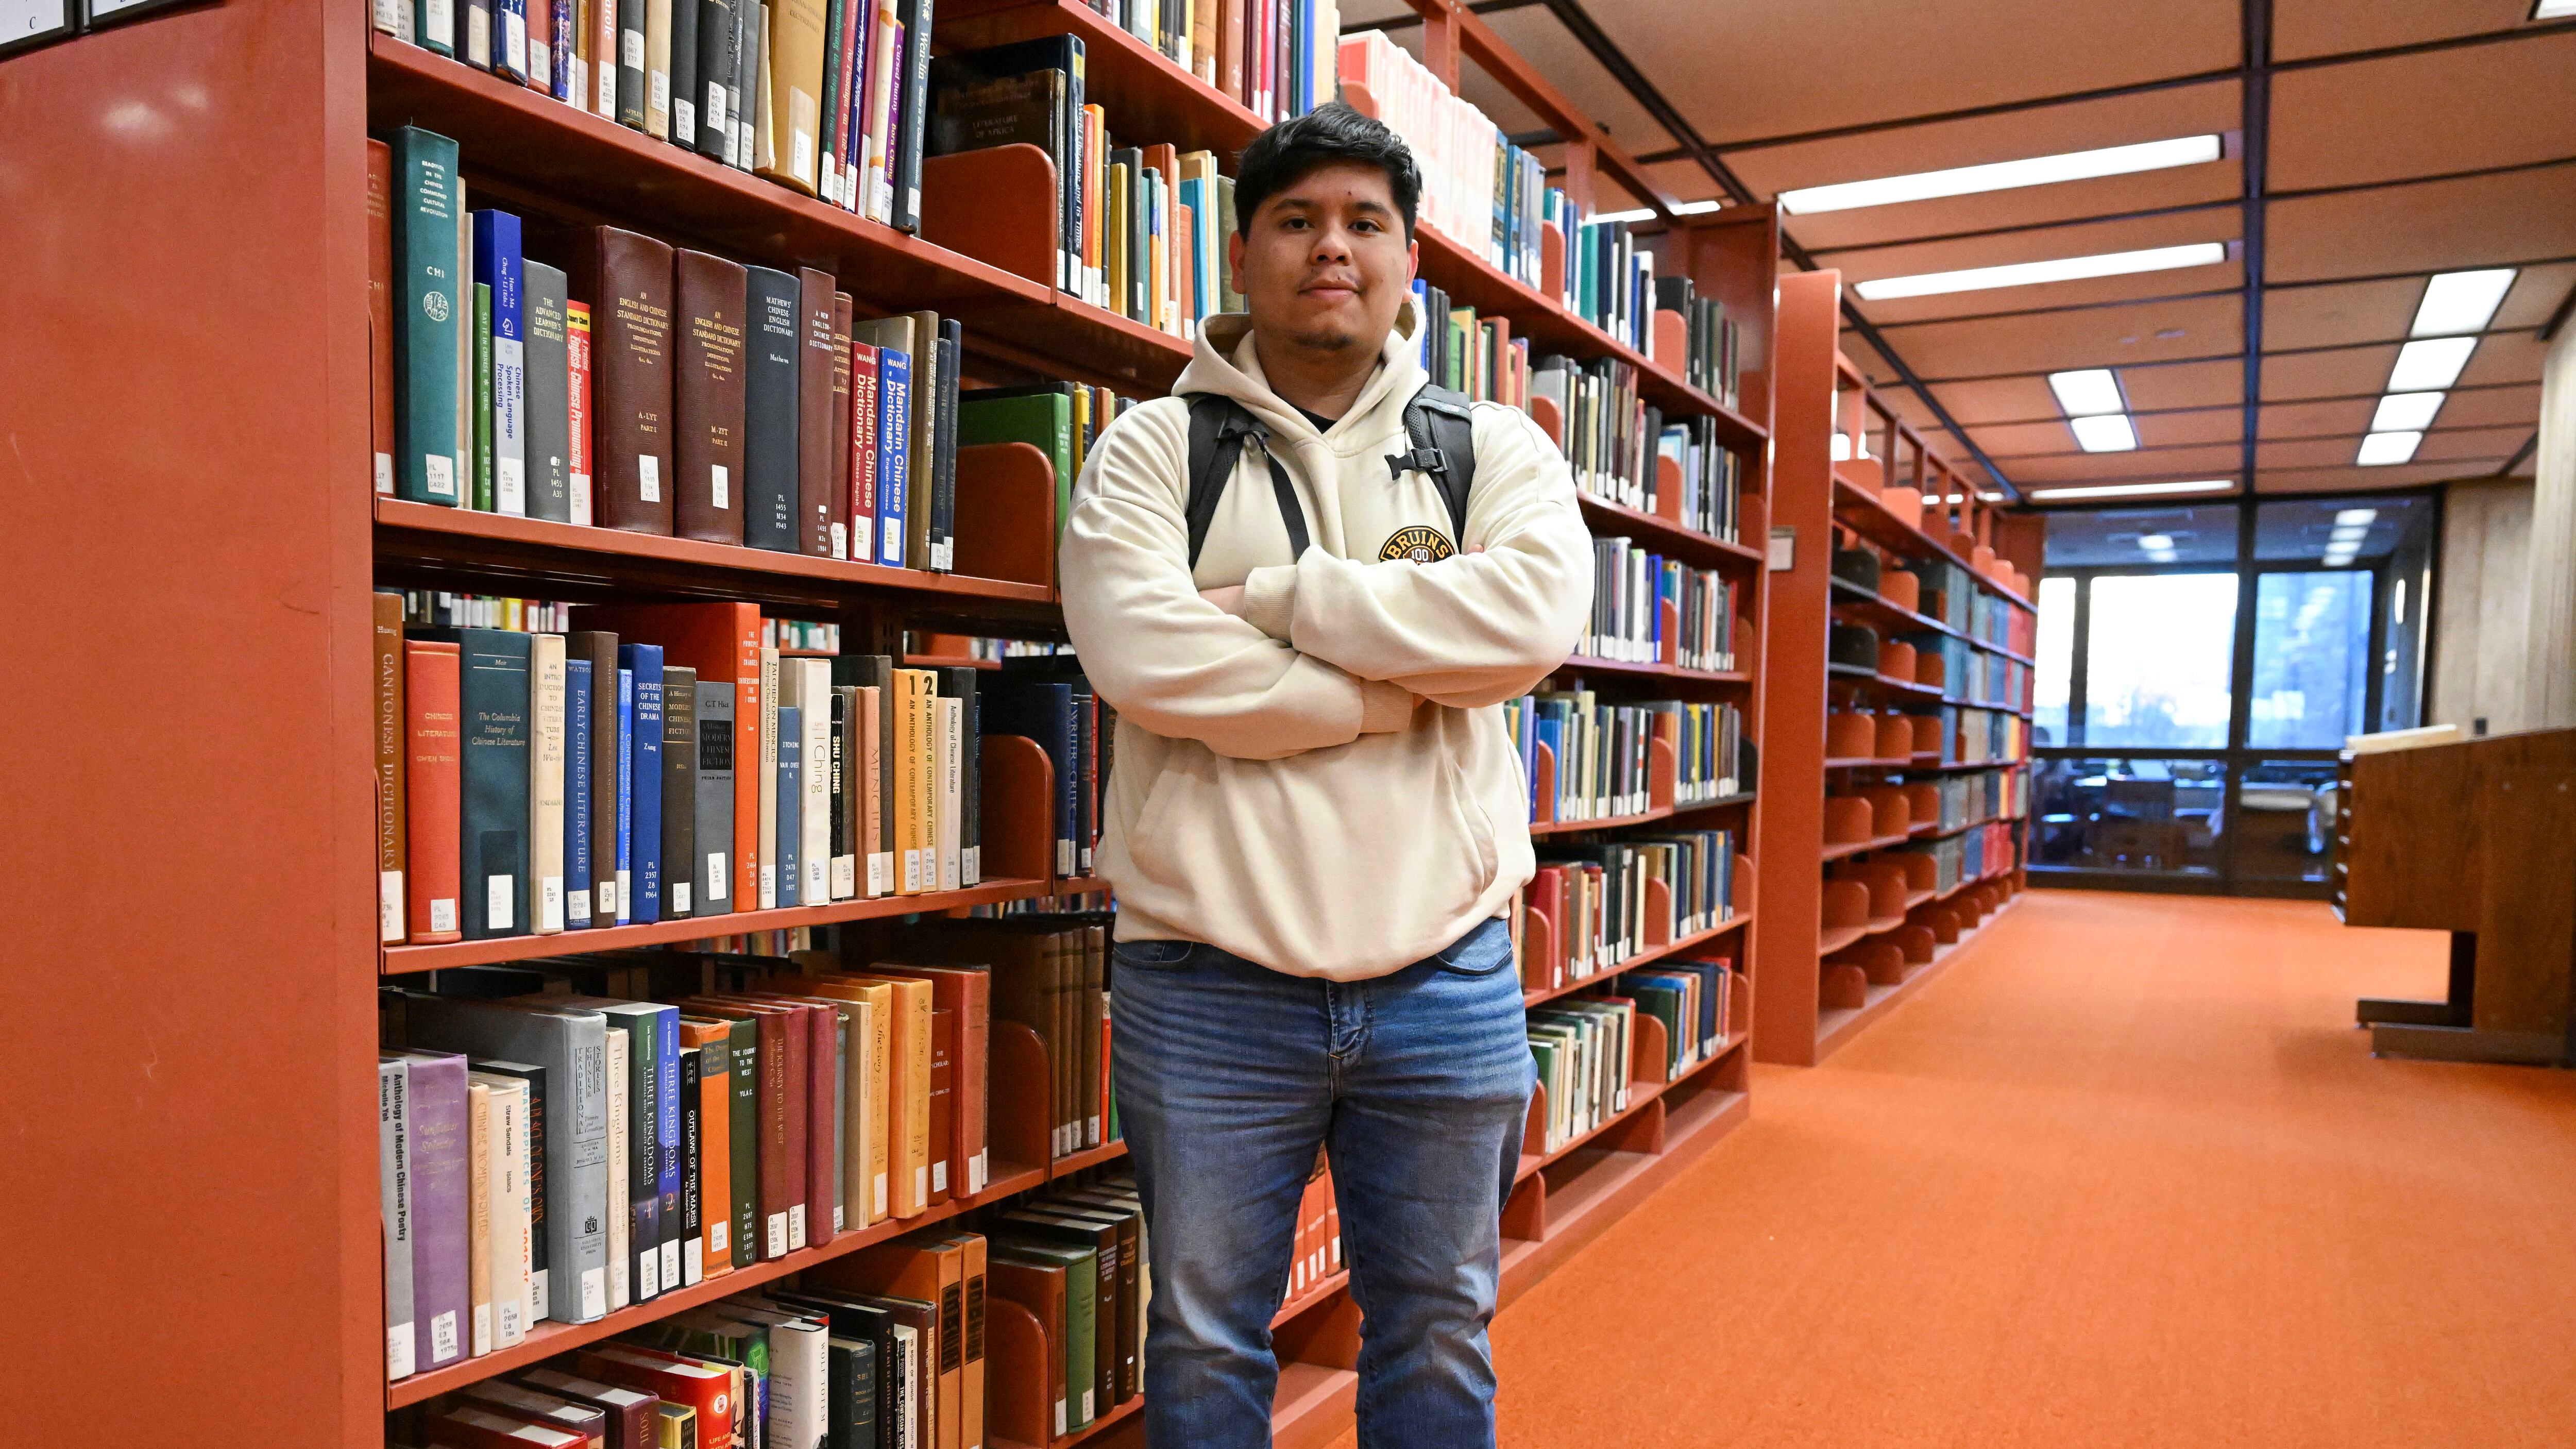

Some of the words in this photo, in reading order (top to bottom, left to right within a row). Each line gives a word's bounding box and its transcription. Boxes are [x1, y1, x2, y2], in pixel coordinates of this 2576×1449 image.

[29, 16, 36, 29] C
[894, 44, 902, 80] Cursed
[918, 32, 928, 80] Wen-lin
[891, 82, 901, 114] Bunny
[887, 149, 895, 180] Chung
[543, 297, 553, 308] THE
[619, 298, 639, 309] ENGLISH
[639, 302, 649, 312] AND
[649, 306, 667, 318] CHINESE
[766, 296, 792, 309] MATHEWS'
[535, 307, 562, 321] ADVANCED
[714, 311, 721, 319] AN
[767, 306, 790, 318] CHINESE-
[820, 311, 829, 320] NEW
[535, 317, 562, 331] LEARNER'S
[617, 310, 642, 323] STANDARD
[643, 316, 669, 330] DICTIONARY
[694, 317, 713, 329] ENGLISH
[714, 322, 722, 331] AND
[722, 325, 740, 336] CHINESE
[769, 316, 790, 326] ENGLISH
[534, 327, 564, 342] DICTIONARY
[692, 328, 717, 341] STANDARD
[717, 335, 741, 348] DICTIONARY
[764, 324, 793, 338] DICTIONARY
[814, 330, 831, 341] CHINESE
[809, 339, 833, 352] DICTIONARY
[856, 352, 876, 365] WANG
[887, 358, 907, 370] WANG
[569, 334, 583, 408] English-Chinese
[855, 373, 867, 449] Dictionary
[866, 376, 876, 445] Mandarin
[885, 378, 896, 454] Dictionary
[894, 382, 906, 450] Mandarin
[569, 408, 582, 468] Pronouncing
[865, 450, 875, 508] Chinese
[893, 454, 904, 513] Chinese
[552, 490, 563, 498] A35
[778, 494, 785, 502] PL
[775, 503, 787, 512] 1455
[776, 521, 787, 530] 1943
[817, 525, 827, 533] 1455
[817, 545, 827, 553] 1984
[1387, 531, 1449, 559] BRUINS
[1412, 548, 1429, 562] 100
[638, 682, 661, 691] SECRETS
[910, 675, 915, 695] 1
[924, 676, 933, 695] 2
[383, 653, 394, 754] CANTONESE
[650, 693, 659, 701] THE
[926, 699, 932, 709] AN
[578, 690, 586, 730] EARLY
[638, 702, 660, 711] CHINESE
[771, 705, 777, 718] ON
[909, 699, 916, 710] AN
[479, 713, 490, 721] The
[492, 713, 521, 722] Columbia
[640, 712, 659, 720] DRAMA
[485, 725, 506, 735] History
[508, 725, 515, 734] of
[472, 737, 496, 746] Chinese
[497, 737, 526, 746] Literature
[833, 735, 841, 759] SHU
[578, 733, 586, 788] CHINESE
[910, 755, 916, 765] OF
[926, 754, 933, 764] OF
[832, 761, 841, 794] CHING
[383, 762, 395, 870] DICTIONARY
[577, 791, 586, 873] LITERATURE
[648, 861, 655, 869] PL
[645, 871, 657, 879] 2357
[646, 891, 657, 899] 1964
[613, 1044, 622, 1088] Three
[393, 1074, 403, 1120] Anthology
[395, 1123, 404, 1133] of
[611, 1092, 623, 1165] Kingdoms
[521, 1086, 530, 1185] MASTERPIECES
[395, 1134, 404, 1170] Modern
[689, 1158, 696, 1170] OF
[396, 1171, 405, 1209] Chinese
[522, 1197, 530, 1213] OF
[743, 1211, 753, 1220] 2697
[397, 1210, 406, 1241] Poetry
[744, 1242, 753, 1251] 1977
[709, 1437, 721, 1445] LIFE
[722, 1431, 731, 1441] AND
